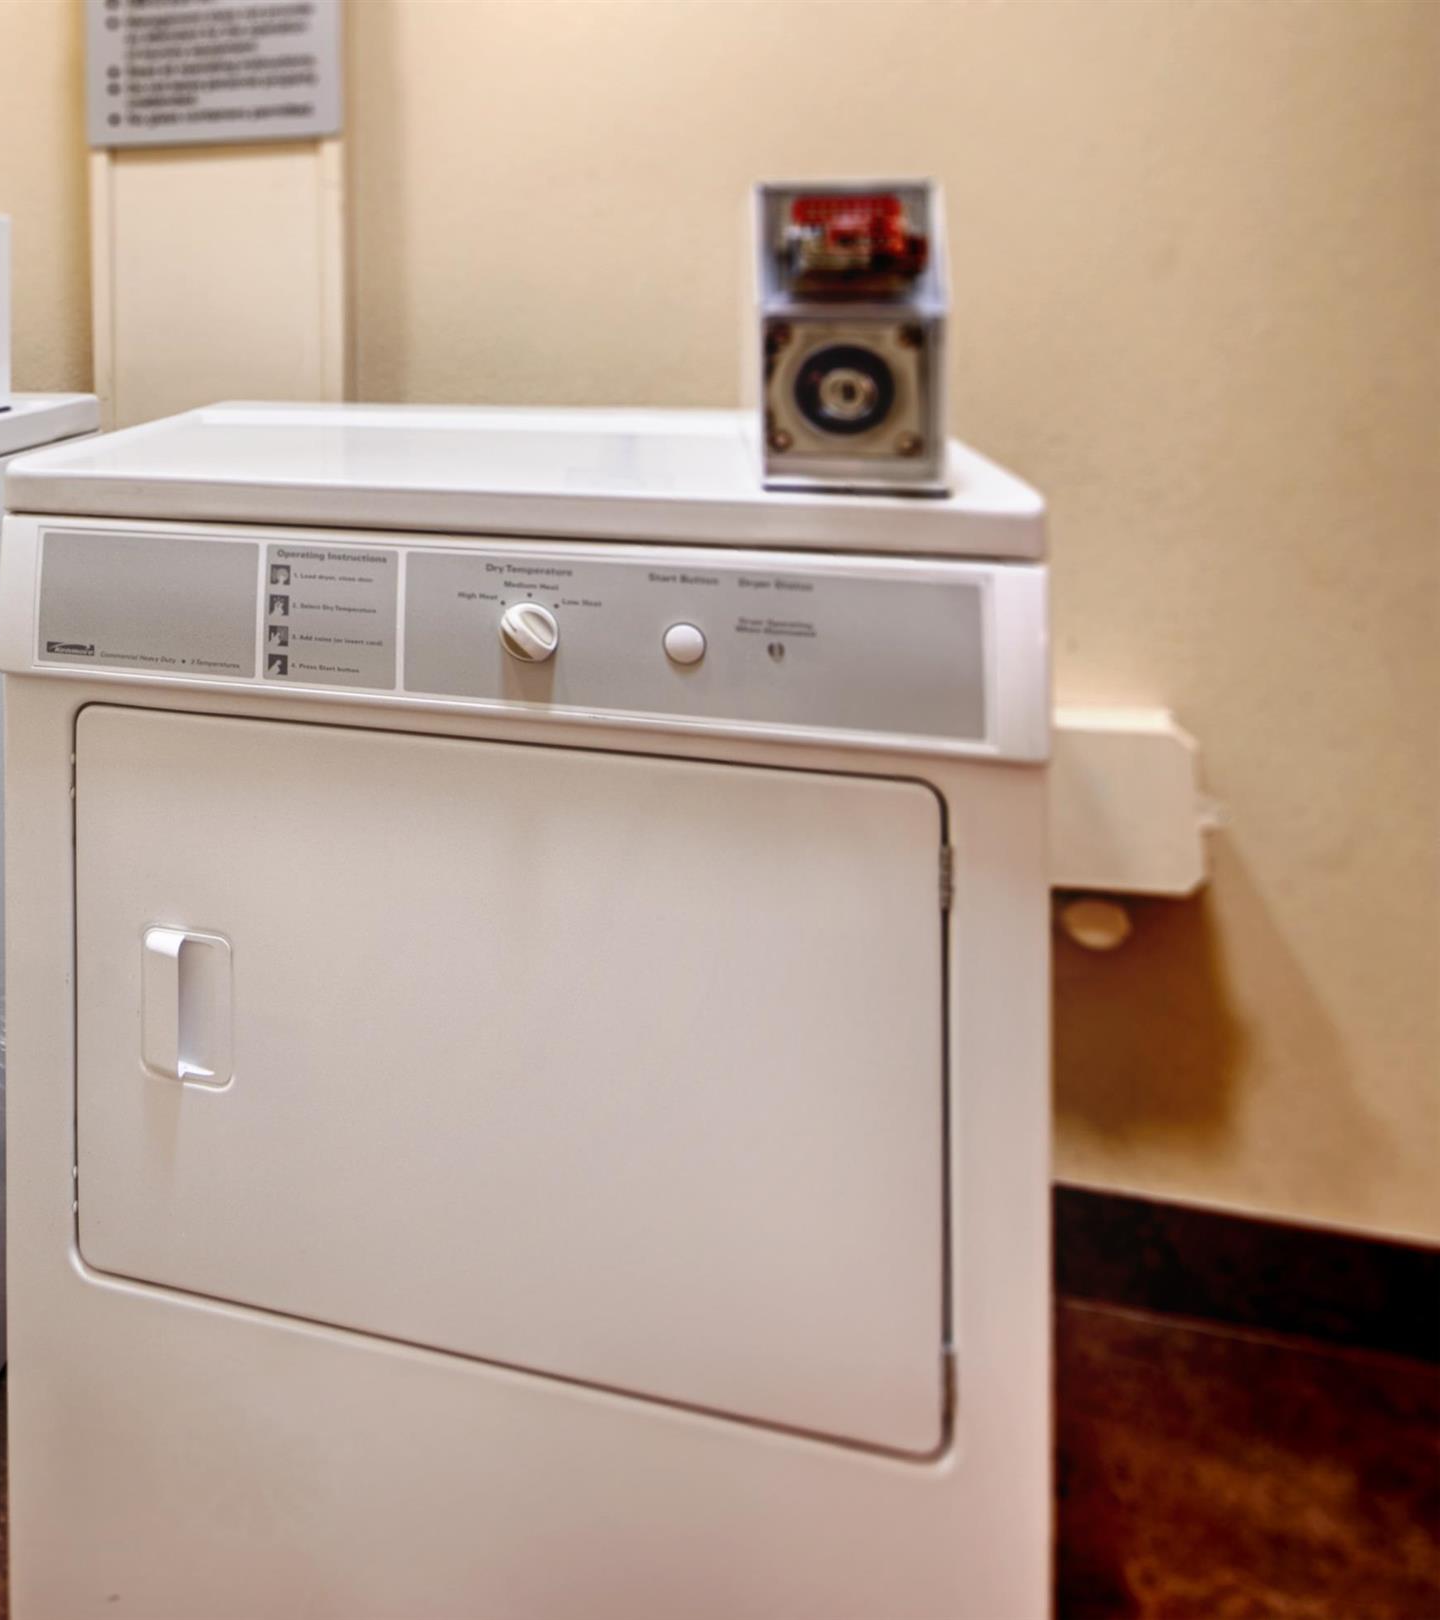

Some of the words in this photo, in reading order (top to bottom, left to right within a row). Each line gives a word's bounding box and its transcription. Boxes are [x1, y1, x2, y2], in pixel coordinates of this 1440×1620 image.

[276, 549, 326, 562] Operating
[328, 551, 387, 564] Instructions
[485, 563, 504, 574] Dry
[505, 564, 573, 577] Temperature
[503, 580, 538, 589] Medium
[539, 583, 559, 591] Heat
[458, 591, 478, 600] High
[561, 598, 580, 606] Low
